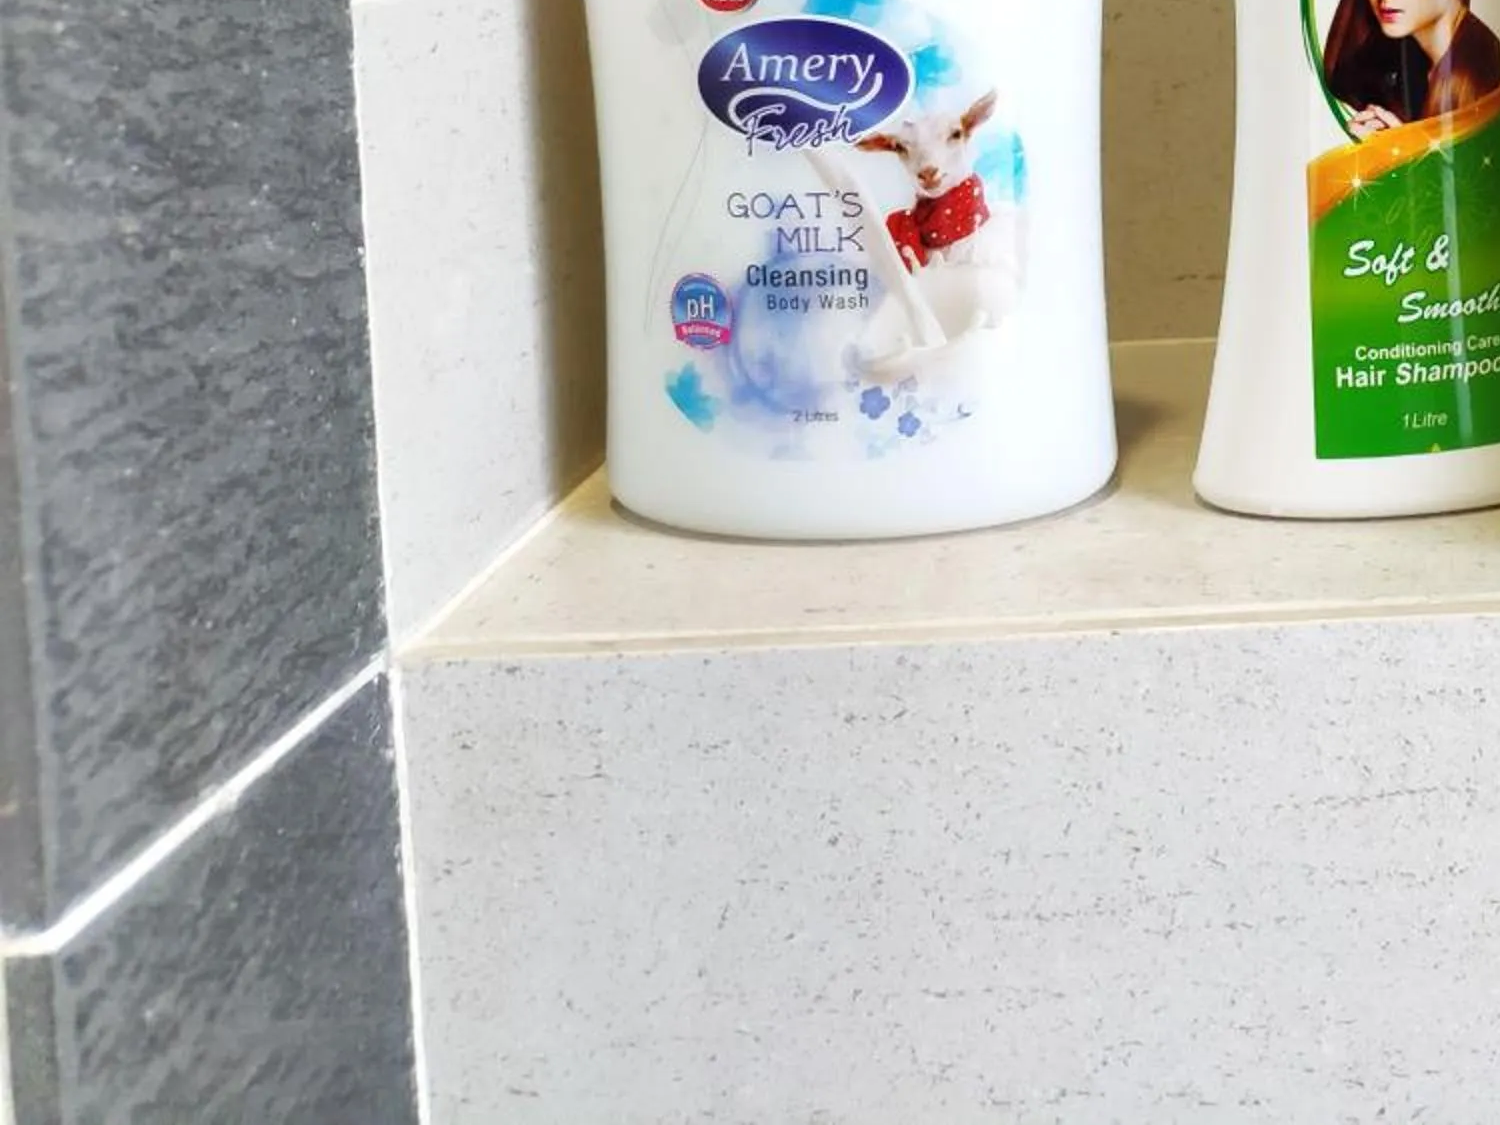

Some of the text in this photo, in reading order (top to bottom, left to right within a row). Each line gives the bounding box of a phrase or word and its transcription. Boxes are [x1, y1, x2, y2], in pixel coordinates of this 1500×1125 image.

[721, 42, 876, 94] Amery
[746, 105, 864, 156] Fresh
[727, 190, 863, 218] GOAT'S
[777, 226, 864, 253] MILK
[1343, 234, 1450, 285] Soft &
[746, 264, 868, 289] Cleansing
[686, 294, 715, 321] pH
[767, 293, 869, 311] Body Wash
[1355, 334, 1500, 361] Conditioning Care
[1336, 366, 1386, 388] Hair
